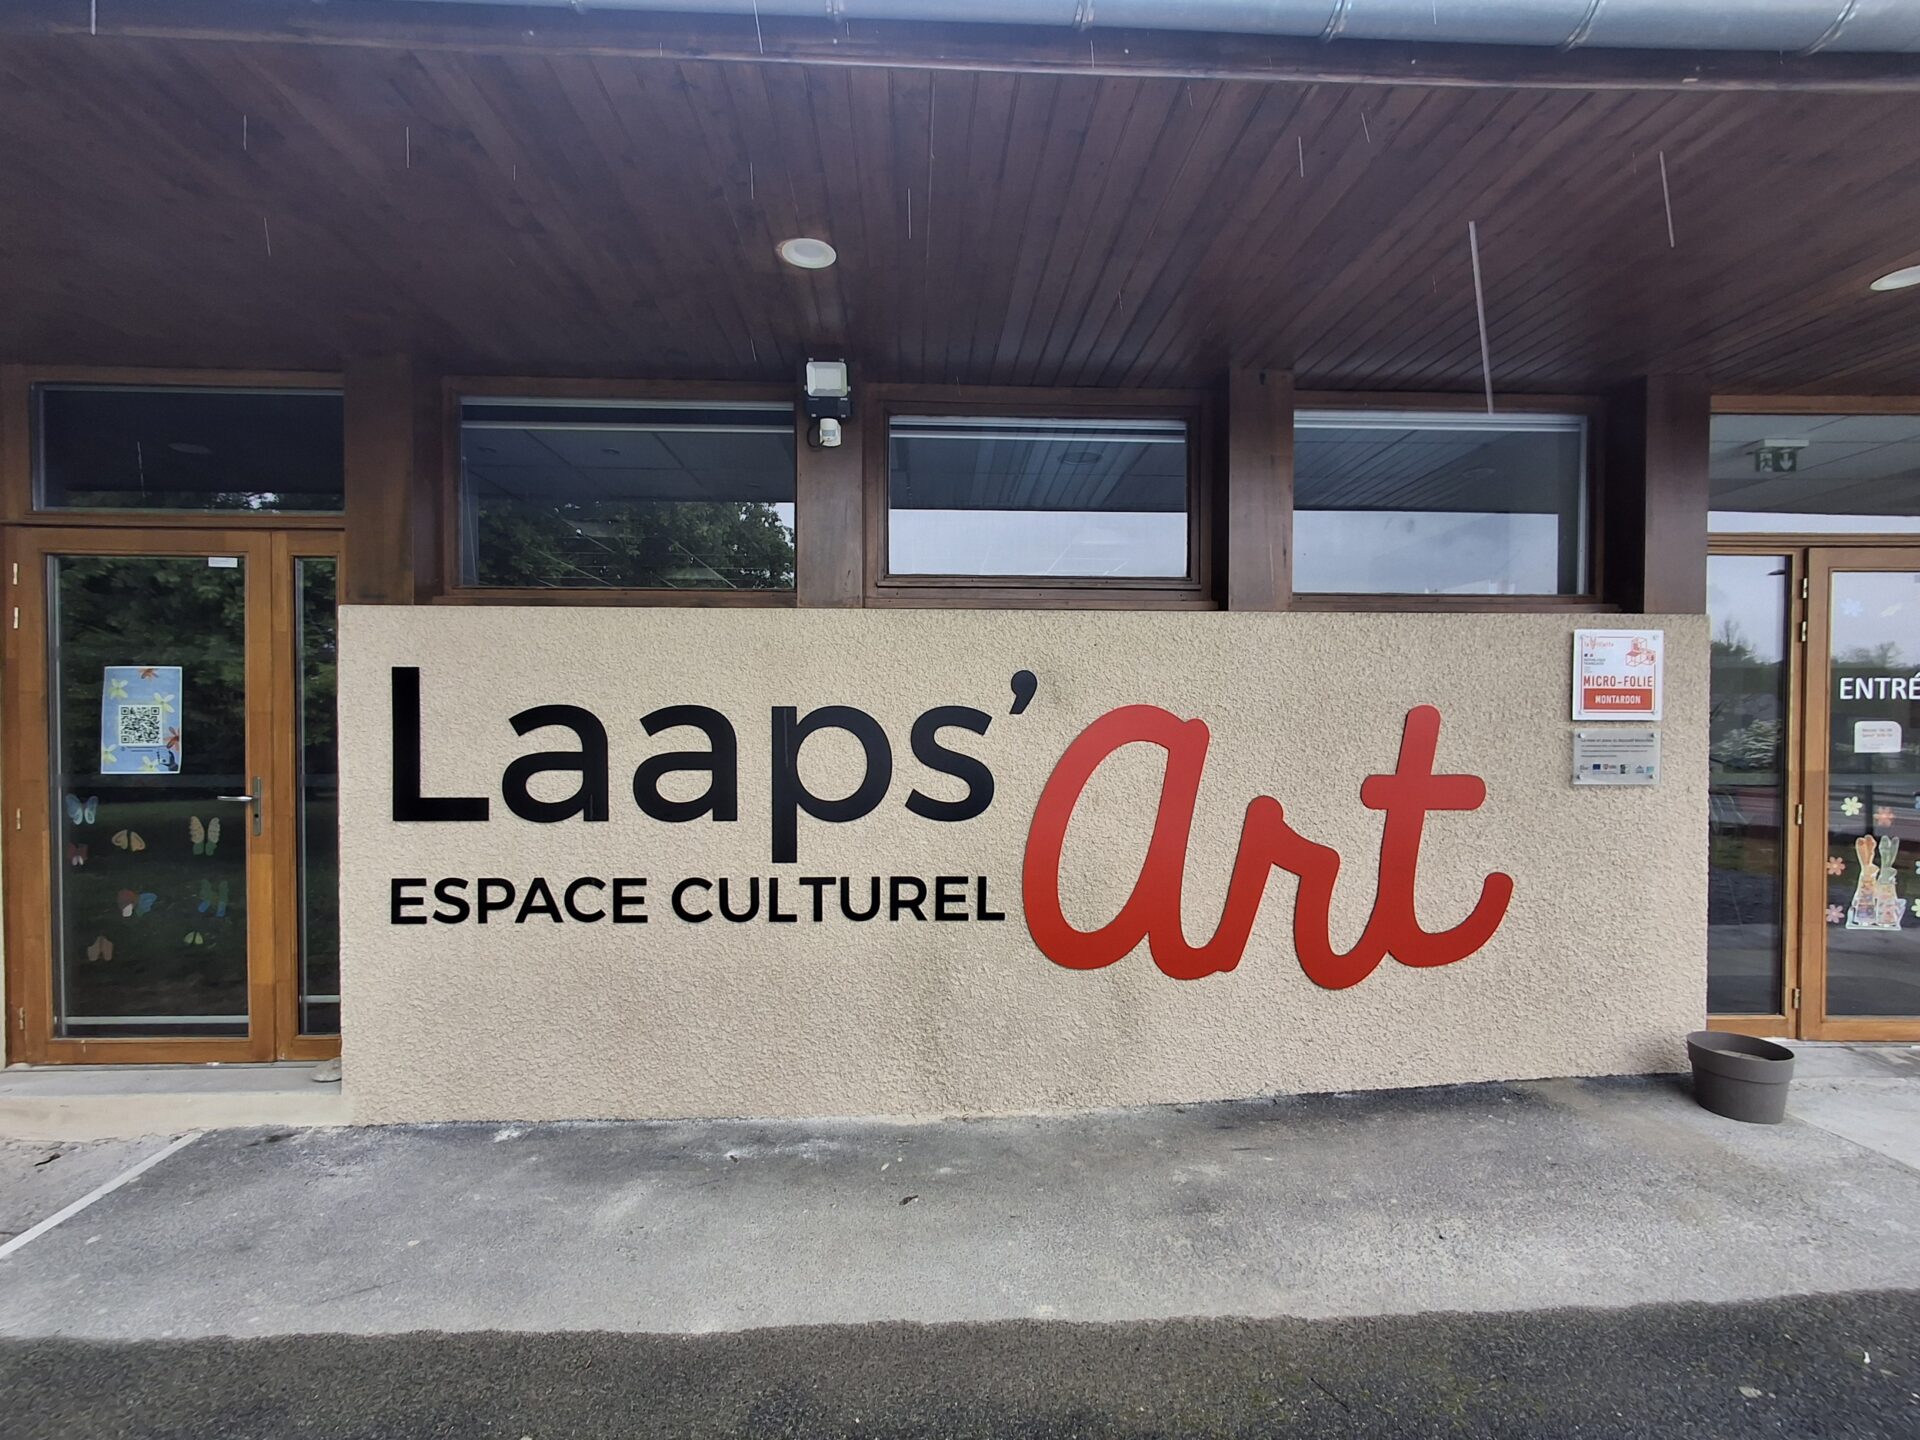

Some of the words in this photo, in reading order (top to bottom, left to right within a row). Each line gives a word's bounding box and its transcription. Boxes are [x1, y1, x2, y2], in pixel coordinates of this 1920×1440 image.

[1583, 675, 1653, 687] MICRO-FOLIE
[1594, 694, 1641, 704] MONTARDON
[391, 877, 648, 925] ESPACE
[672, 876, 1006, 924] CULTUREL
